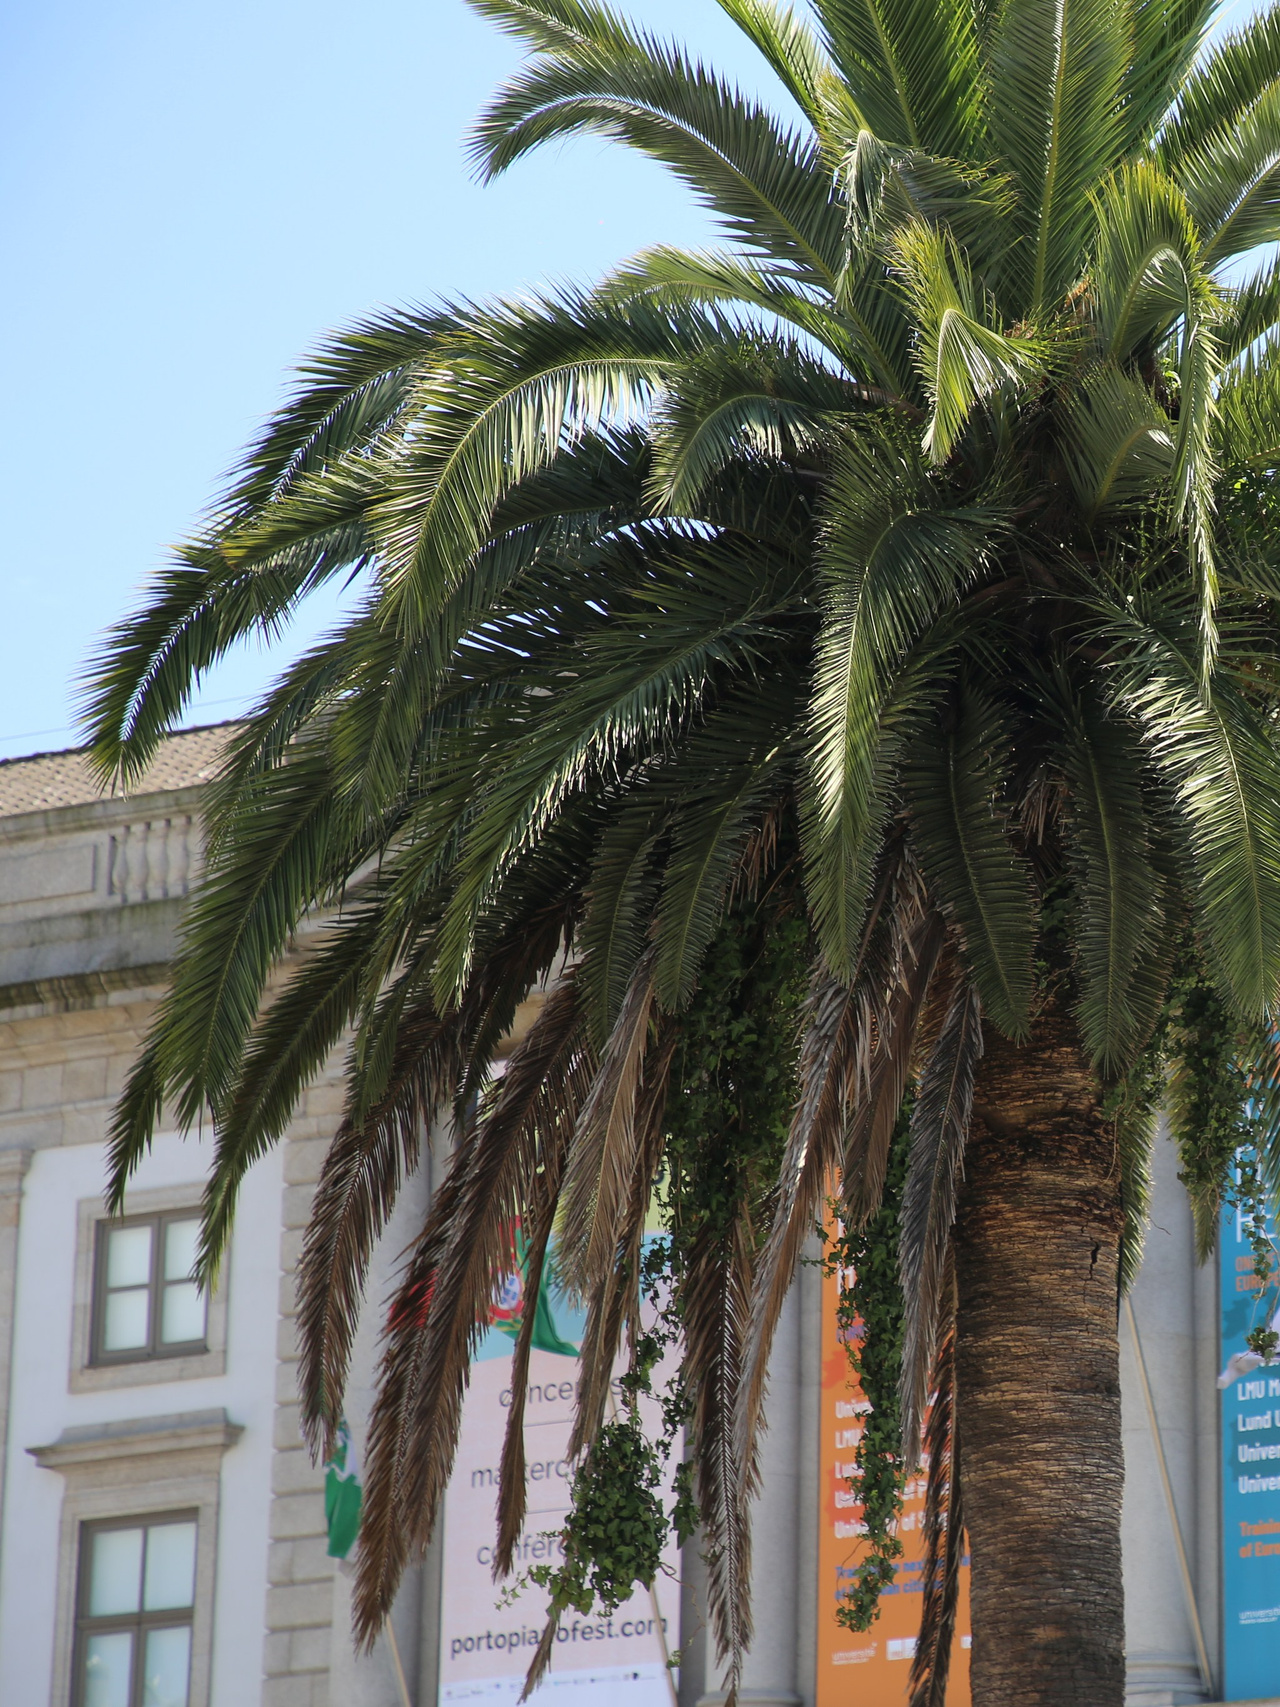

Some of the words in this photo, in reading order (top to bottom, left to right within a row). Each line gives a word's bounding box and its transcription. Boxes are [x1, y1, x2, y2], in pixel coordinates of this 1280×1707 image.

[1237, 1379, 1266, 1401] LMU
[1237, 1410, 1273, 1432] Lund
[901, 1512, 916, 1531] of
[1239, 1542, 1252, 1558] of
[450, 1617, 668, 1660] portopiaofest.com
